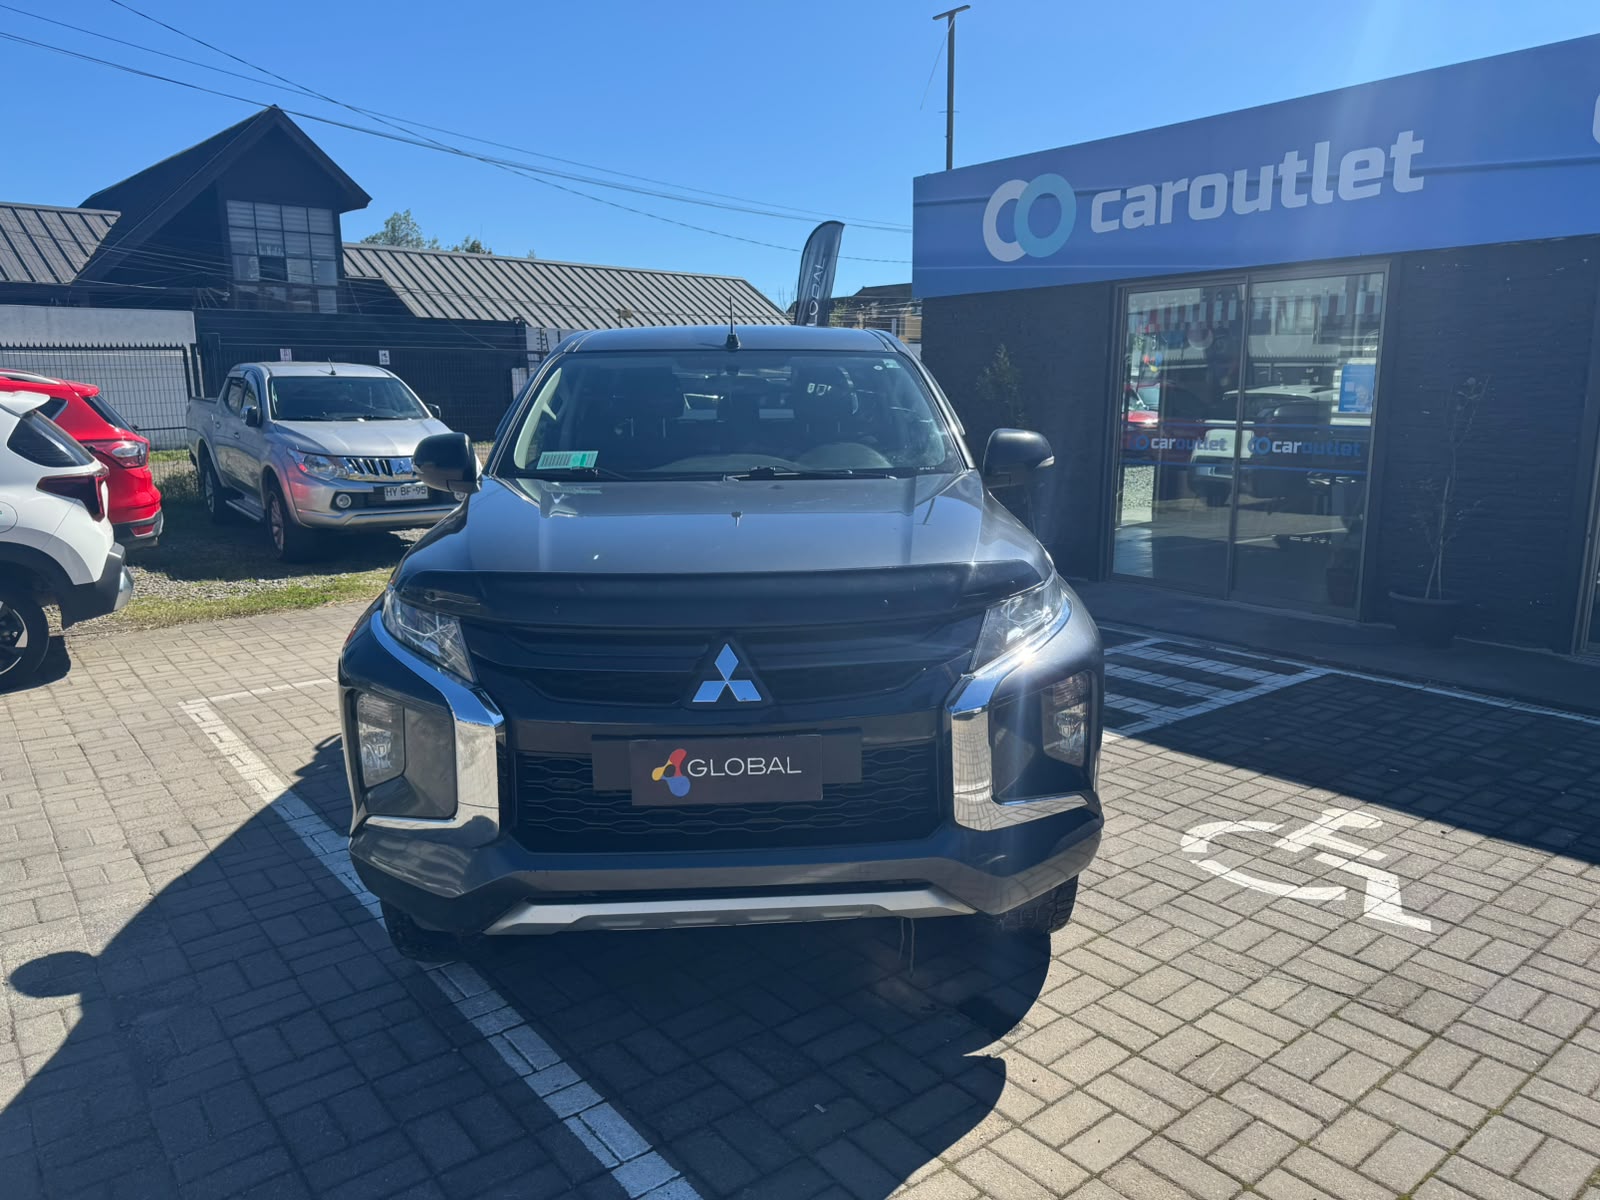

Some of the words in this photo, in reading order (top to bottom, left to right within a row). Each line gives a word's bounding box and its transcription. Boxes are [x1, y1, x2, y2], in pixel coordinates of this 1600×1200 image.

[1090, 130, 1424, 233] caroutlet
[805, 258, 826, 326] LOBAL
[1151, 437, 1228, 451] caroutlet
[1272, 440, 1361, 456] caroutlet
[687, 756, 802, 777] GLOBAL
